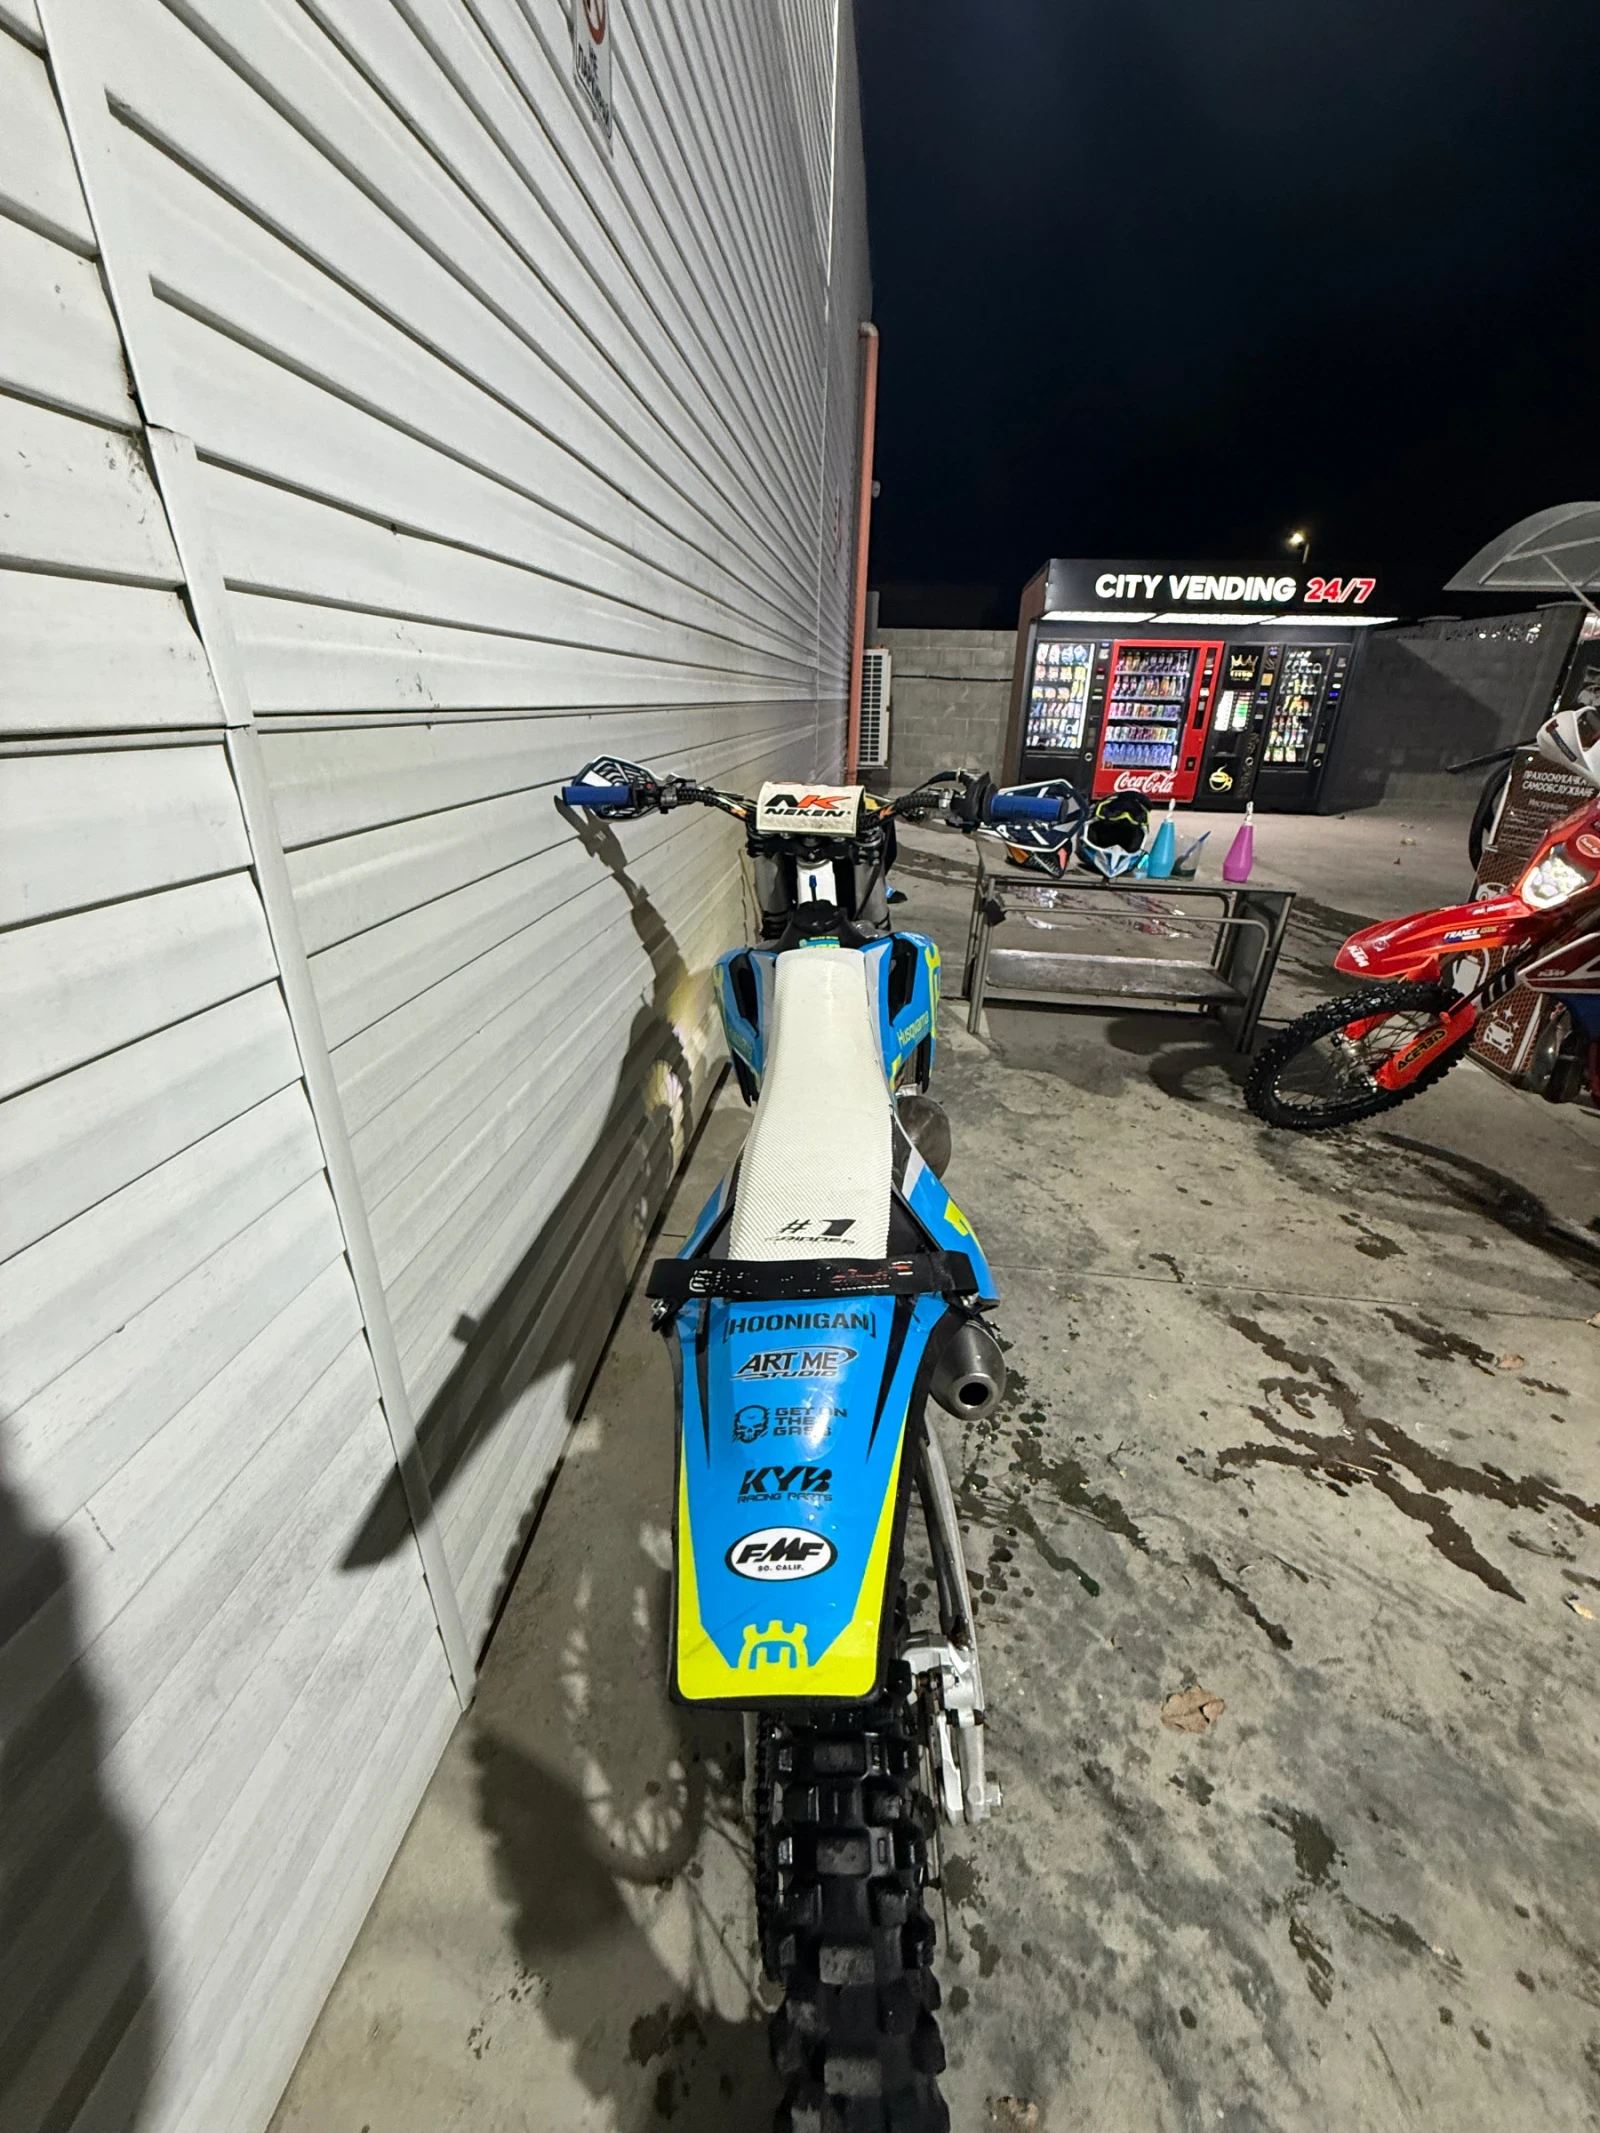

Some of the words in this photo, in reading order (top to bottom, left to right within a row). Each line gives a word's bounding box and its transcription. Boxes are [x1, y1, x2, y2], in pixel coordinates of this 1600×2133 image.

[1095, 574, 1162, 599] CITY
[1169, 575, 1296, 601] VENDING
[1304, 577, 1376, 604] 24/7
[764, 808, 846, 818] NEKEN
[1443, 927, 1480, 941] FRANCE
[1347, 945, 1370, 968] KTM
[1397, 1029, 1447, 1071] ACERBIS
[737, 1353, 799, 1375] ART
[801, 1351, 839, 1370] ME
[743, 1370, 837, 1381] STUDIO
[775, 1406, 815, 1417] GET
[774, 1416, 816, 1426] THE
[738, 1465, 832, 1495] KYB
[737, 1493, 783, 1504] RACING
[787, 1493, 833, 1502] PARTS
[736, 1537, 825, 1564] FMF
